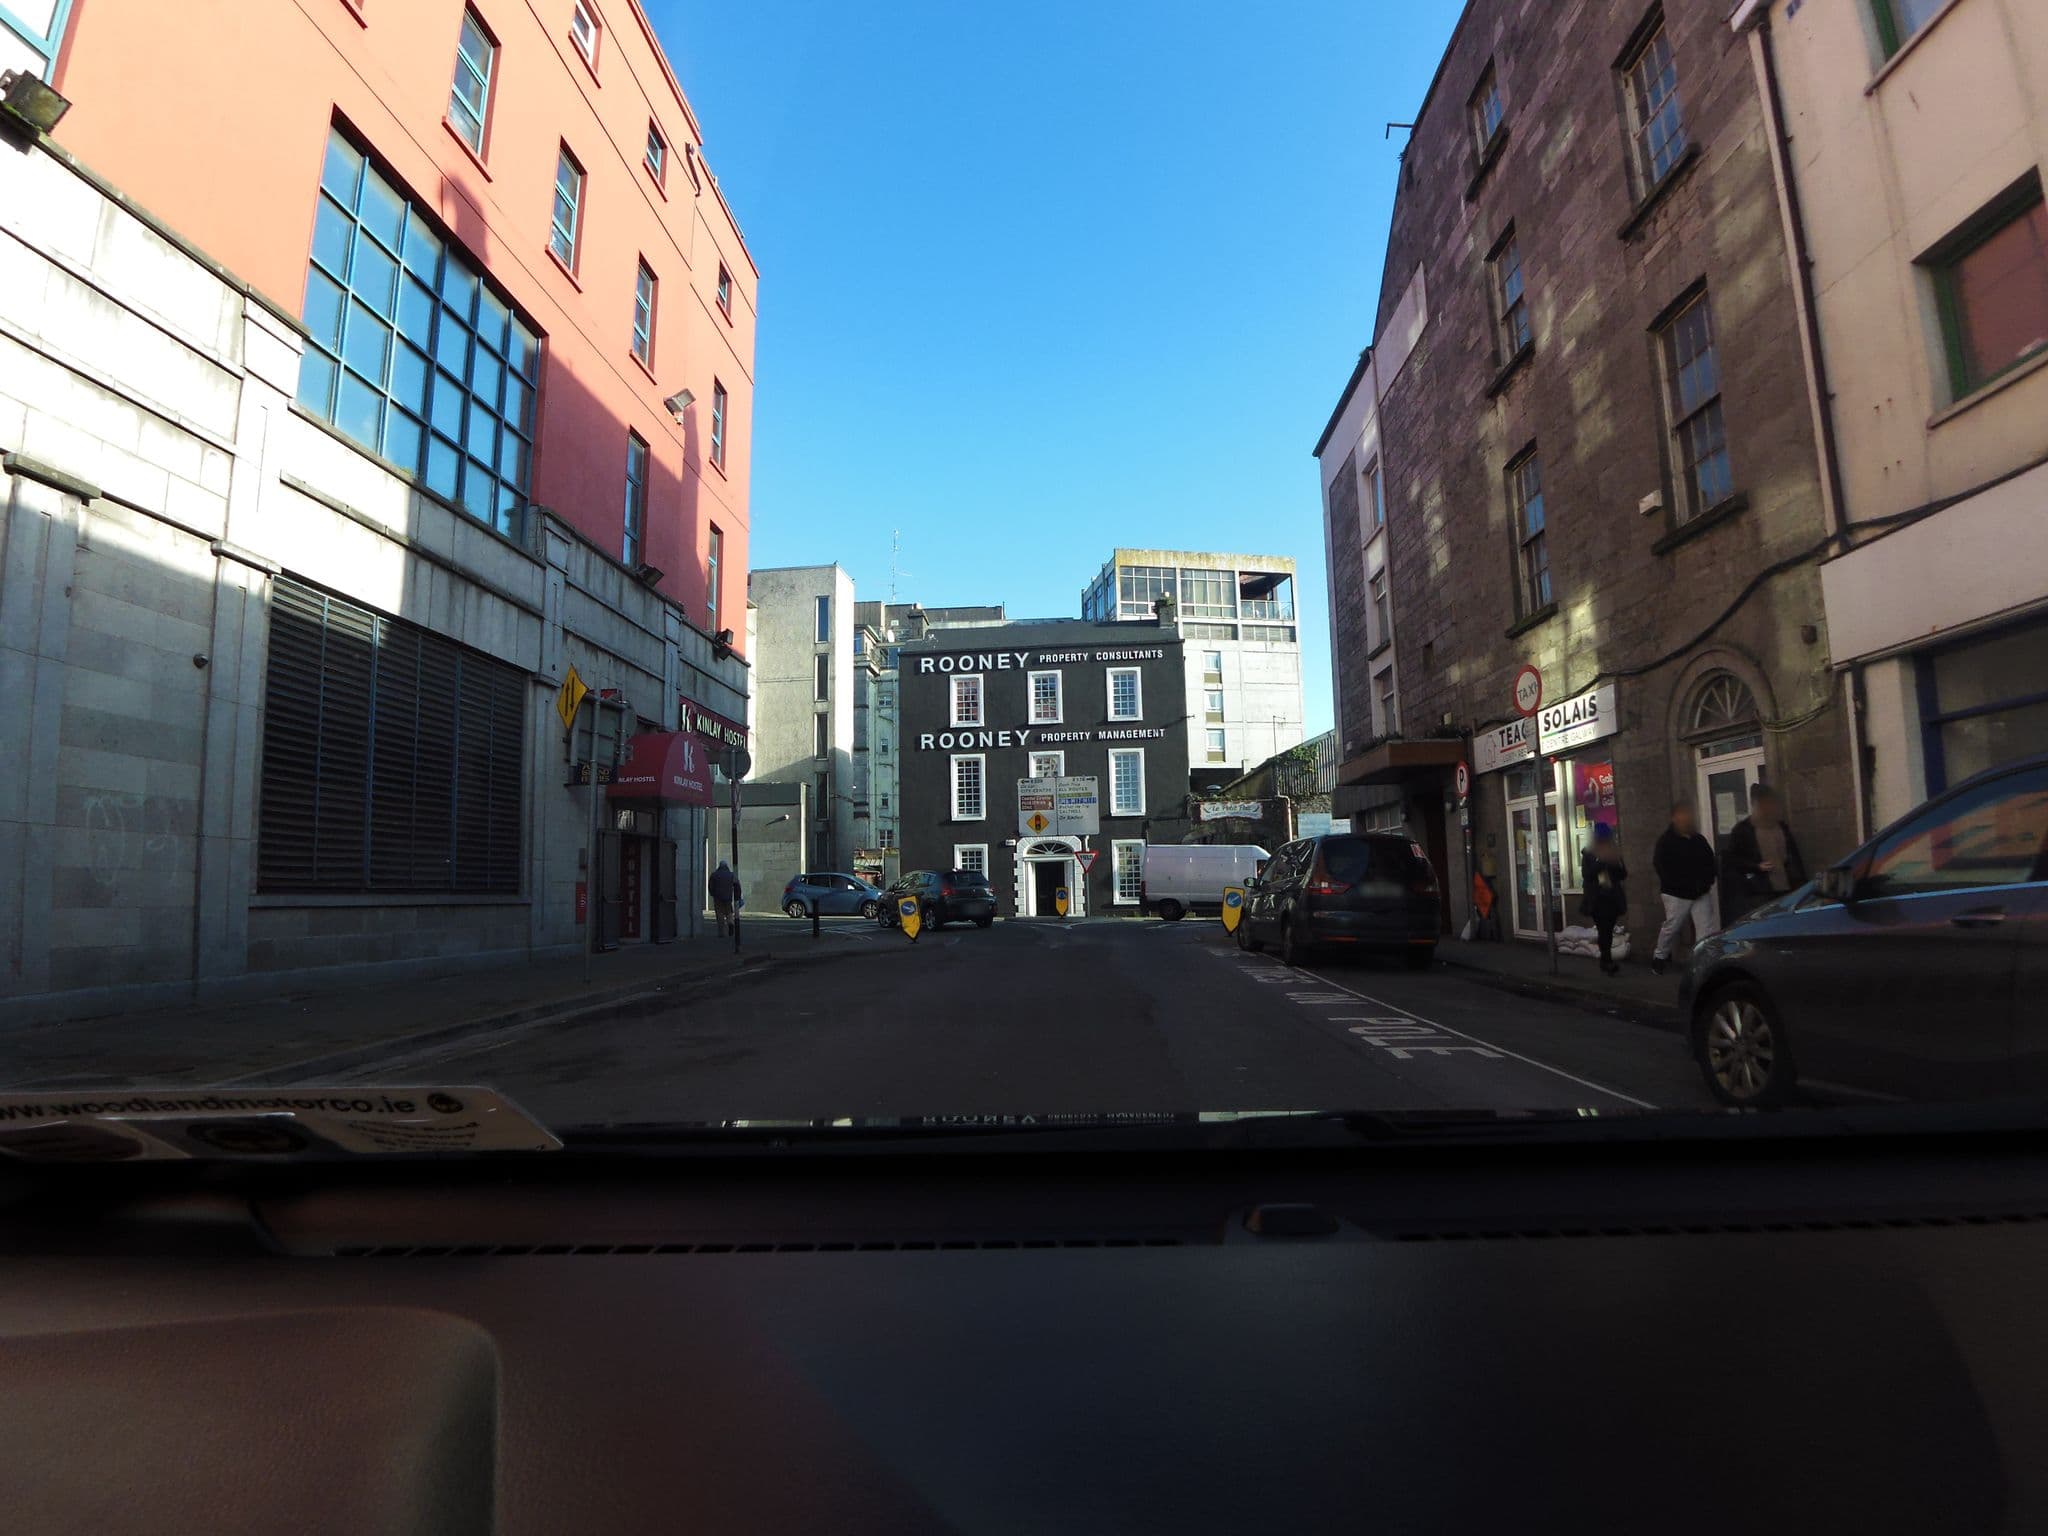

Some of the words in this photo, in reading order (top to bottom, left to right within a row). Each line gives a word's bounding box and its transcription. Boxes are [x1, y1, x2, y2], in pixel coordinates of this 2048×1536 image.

[920, 652, 1030, 673] ROONEY
[1039, 652, 1089, 663] PROPERTY
[1095, 649, 1164, 661] CONSULTANTS
[1543, 695, 1598, 732] SOLAIS
[696, 713, 722, 739] KINLAY
[1545, 734, 1569, 748] CENTRE
[1571, 726, 1596, 741] GALWAY
[920, 730, 1031, 750] ROONEY
[1041, 731, 1091, 742] PROPERTY
[1098, 728, 1166, 739] MANAGEMENT
[673, 775, 688, 788] KINLAY
[688, 780, 703, 791] HOSTEL
[1326, 1016, 1504, 1060] POLE
